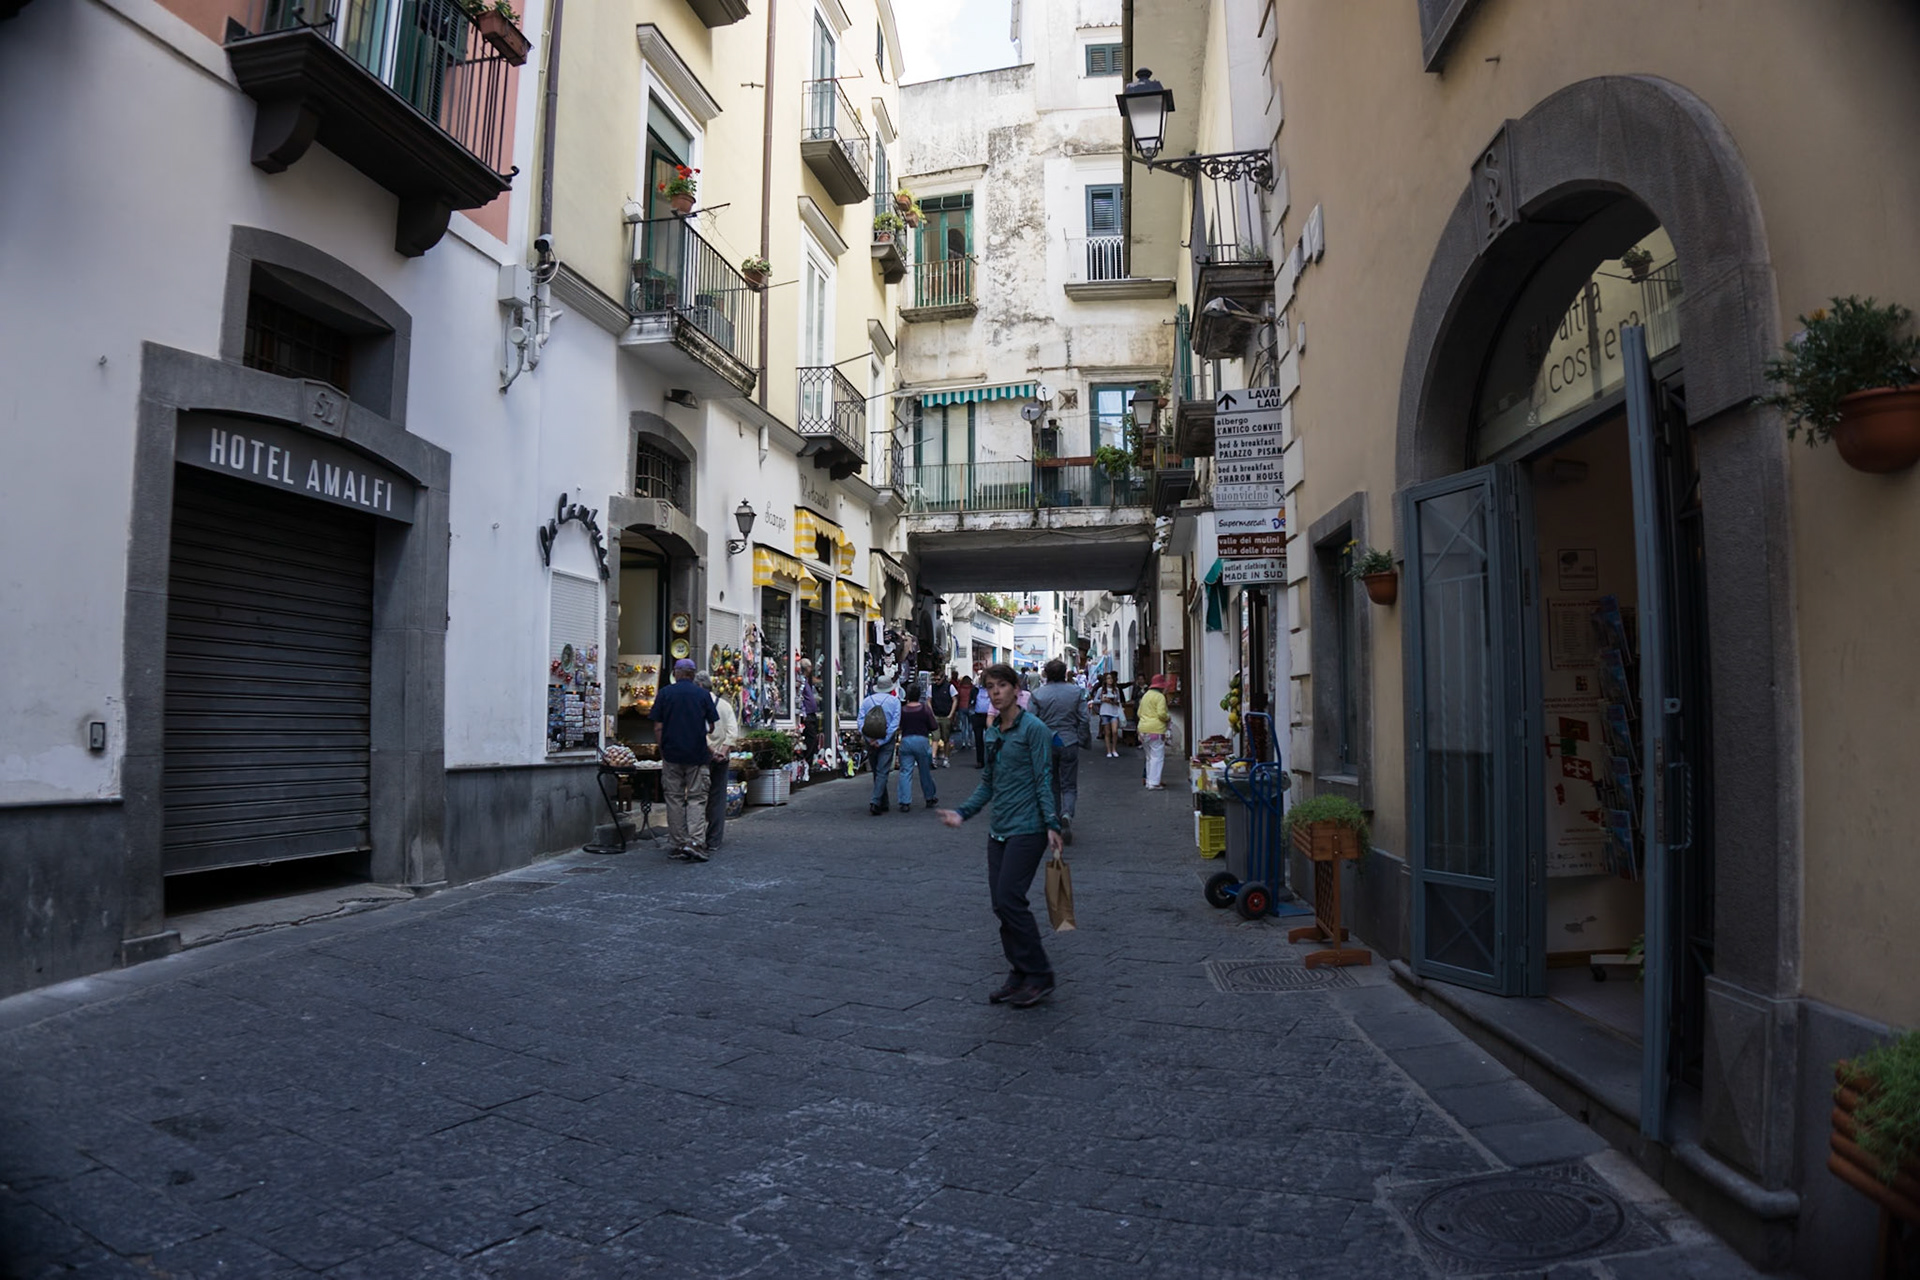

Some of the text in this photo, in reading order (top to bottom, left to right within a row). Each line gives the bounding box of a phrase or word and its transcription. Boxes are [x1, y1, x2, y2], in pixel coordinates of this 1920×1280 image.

[1257, 398, 1281, 408] LAU
[1216, 418, 1248, 426] albergo
[1217, 423, 1282, 435] L'ANTICO CONVIT
[1218, 437, 1275, 449] bed & breakfast
[1219, 448, 1252, 459] PALAZZO
[209, 428, 392, 512] HOTEL AMALFI
[1218, 462, 1274, 474] bed & breakfast
[1218, 471, 1284, 483] SHARON HOUSE
[1218, 518, 1267, 527] Supermercati
[1219, 535, 1280, 545] valle dei mulini
[1219, 547, 1238, 555] valle
[1240, 546, 1259, 555] delle
[1224, 563, 1242, 571] outlet
[1244, 562, 1267, 570] clothing
[1270, 561, 1275, 569] &
[1224, 570, 1283, 581] MADE IN SUD
